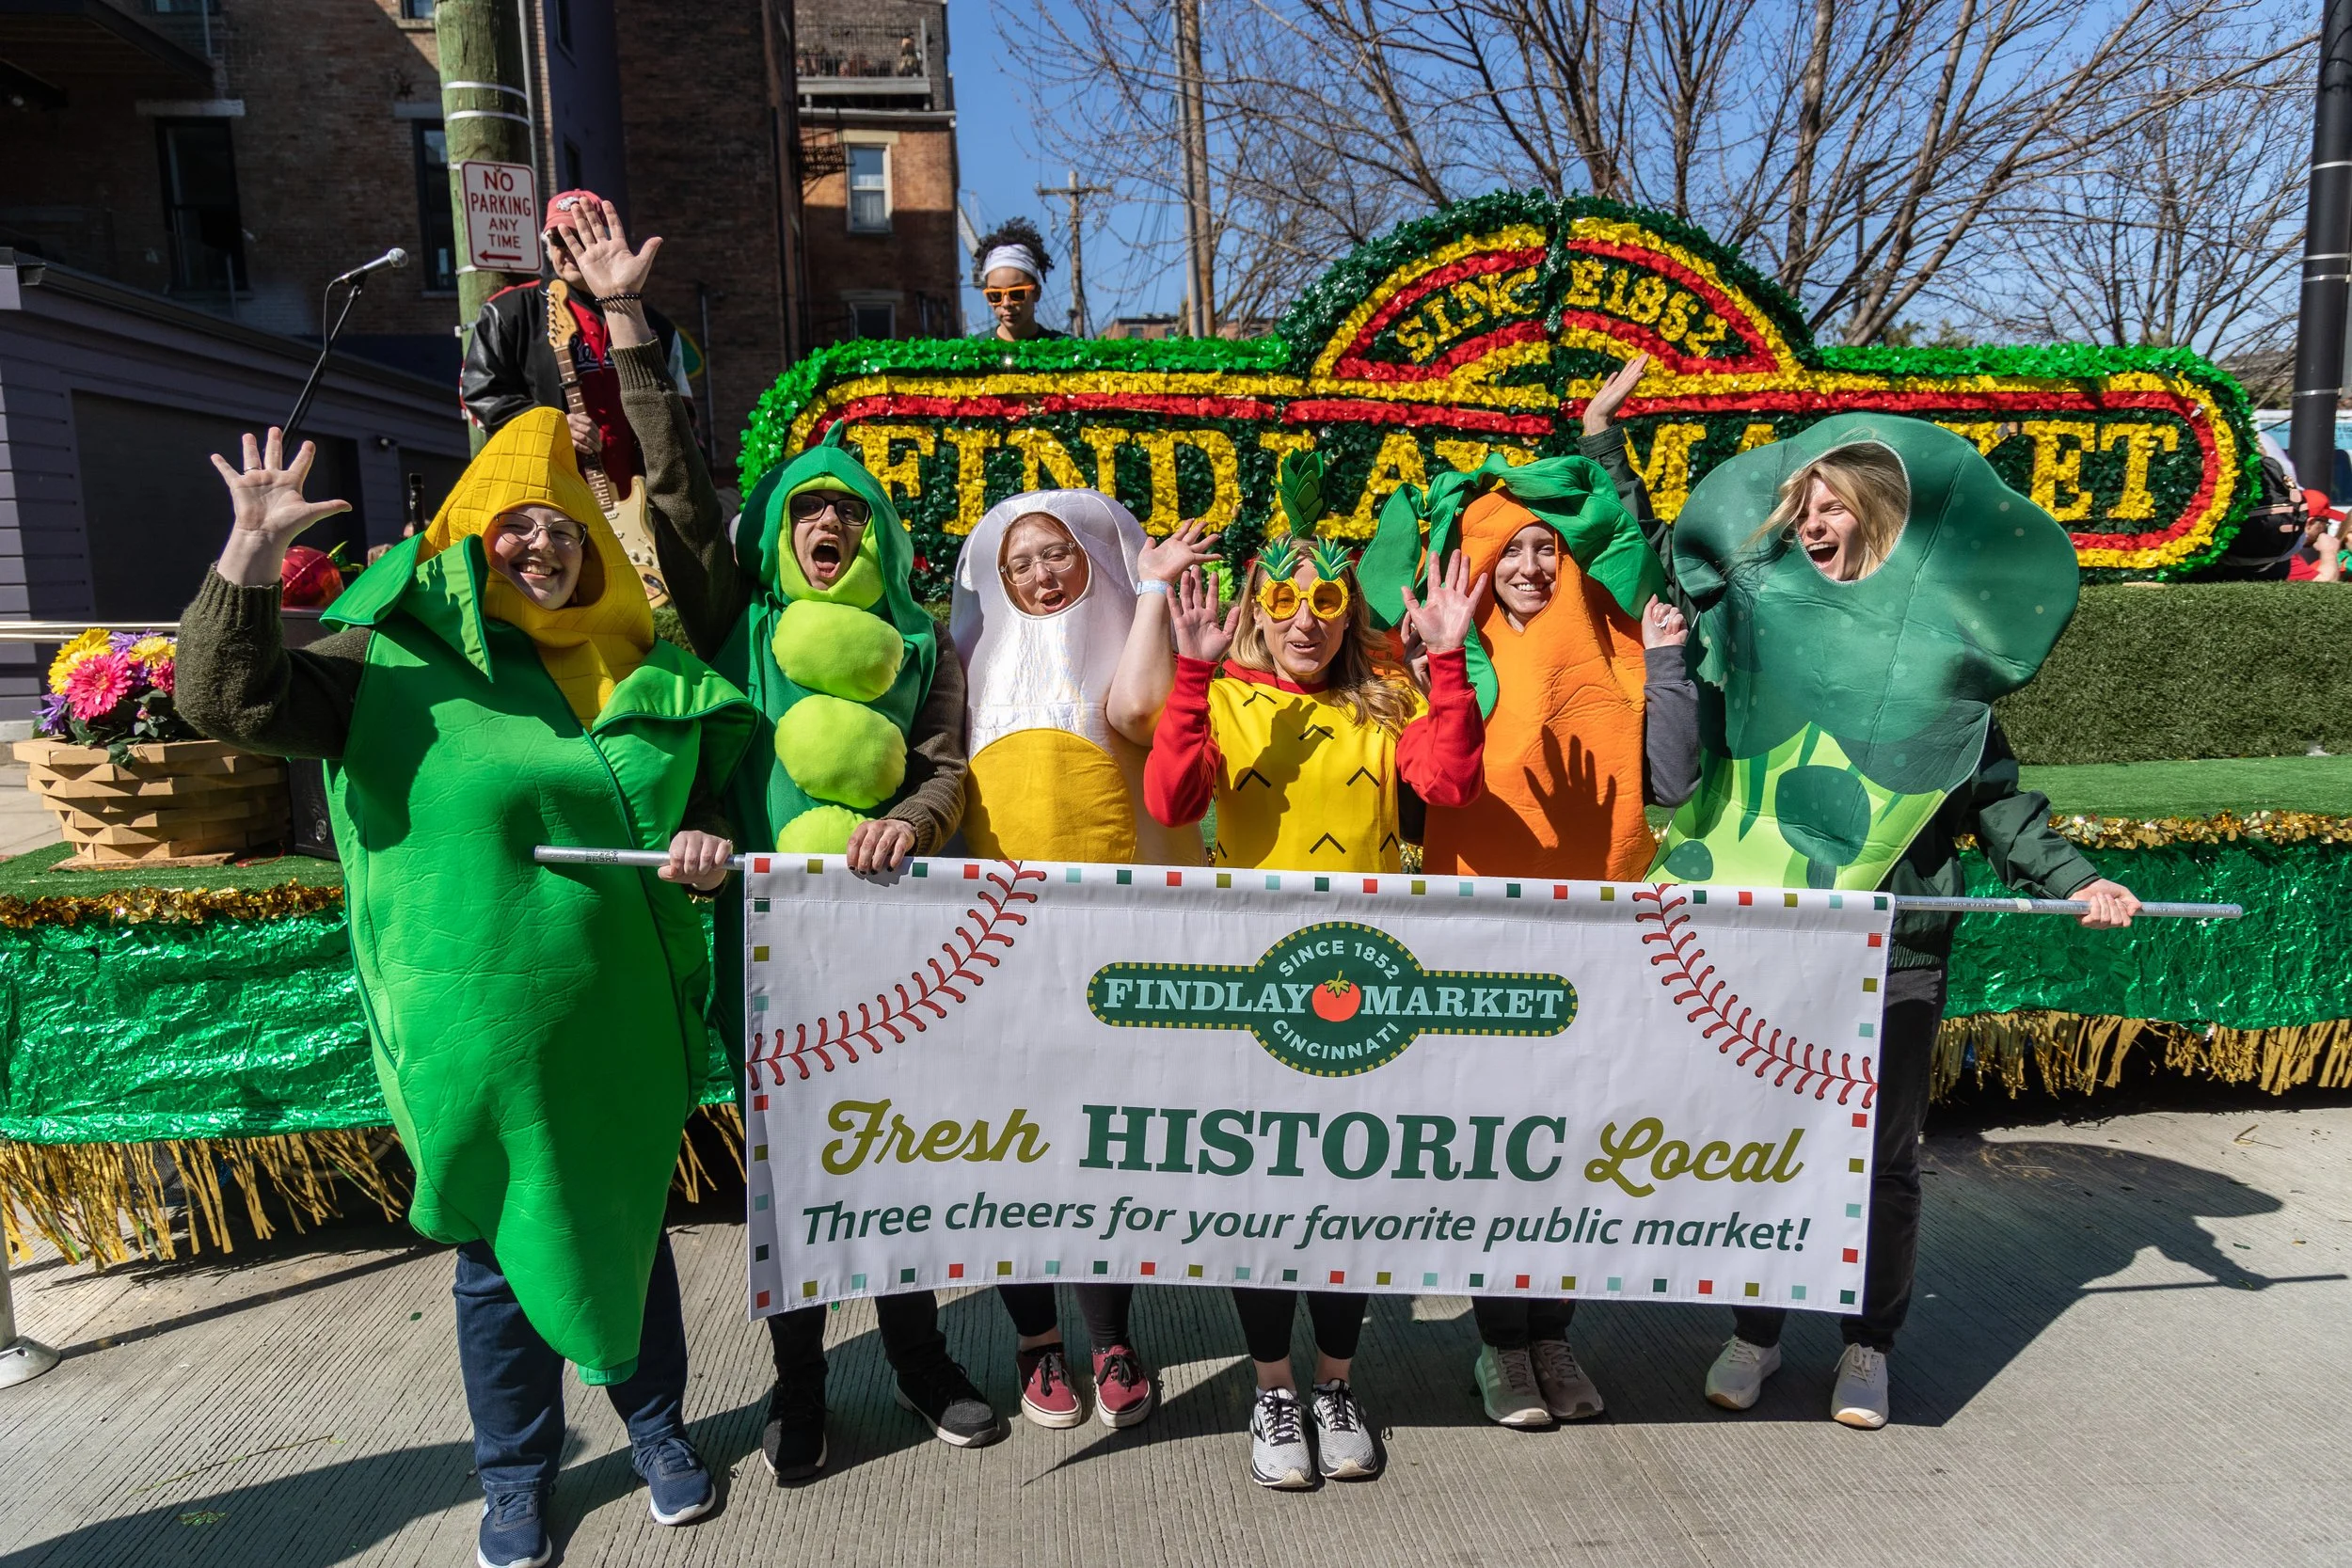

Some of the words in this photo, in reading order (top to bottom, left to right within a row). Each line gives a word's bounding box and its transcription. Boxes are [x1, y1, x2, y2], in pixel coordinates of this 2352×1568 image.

[484, 170, 514, 192] NO
[470, 192, 532, 217] PARKING
[488, 217, 518, 232] ANY
[489, 233, 522, 249] TIME
[1395, 259, 1603, 363] SINCE
[1603, 269, 1728, 357] 1852
[1279, 940, 1344, 977] SINCE
[1355, 942, 1400, 980] 1852
[1104, 977, 1314, 1014] FINDLAY
[1360, 985, 1565, 1020] MARKET
[1273, 1020, 1400, 1060] CINCINNATI
[820, 1098, 1051, 1176] Fresh
[1079, 1103, 1567, 1182] HISTORIC
[1583, 1117, 1806, 1197] Local
[803, 1200, 931, 1245] Three
[945, 1191, 1096, 1230] cheers
[1099, 1196, 1177, 1241] for
[1182, 1209, 1295, 1245] your
[1294, 1203, 1476, 1250] favorite
[1483, 1206, 1620, 1252] public
[1632, 1211, 1812, 1252] market!
